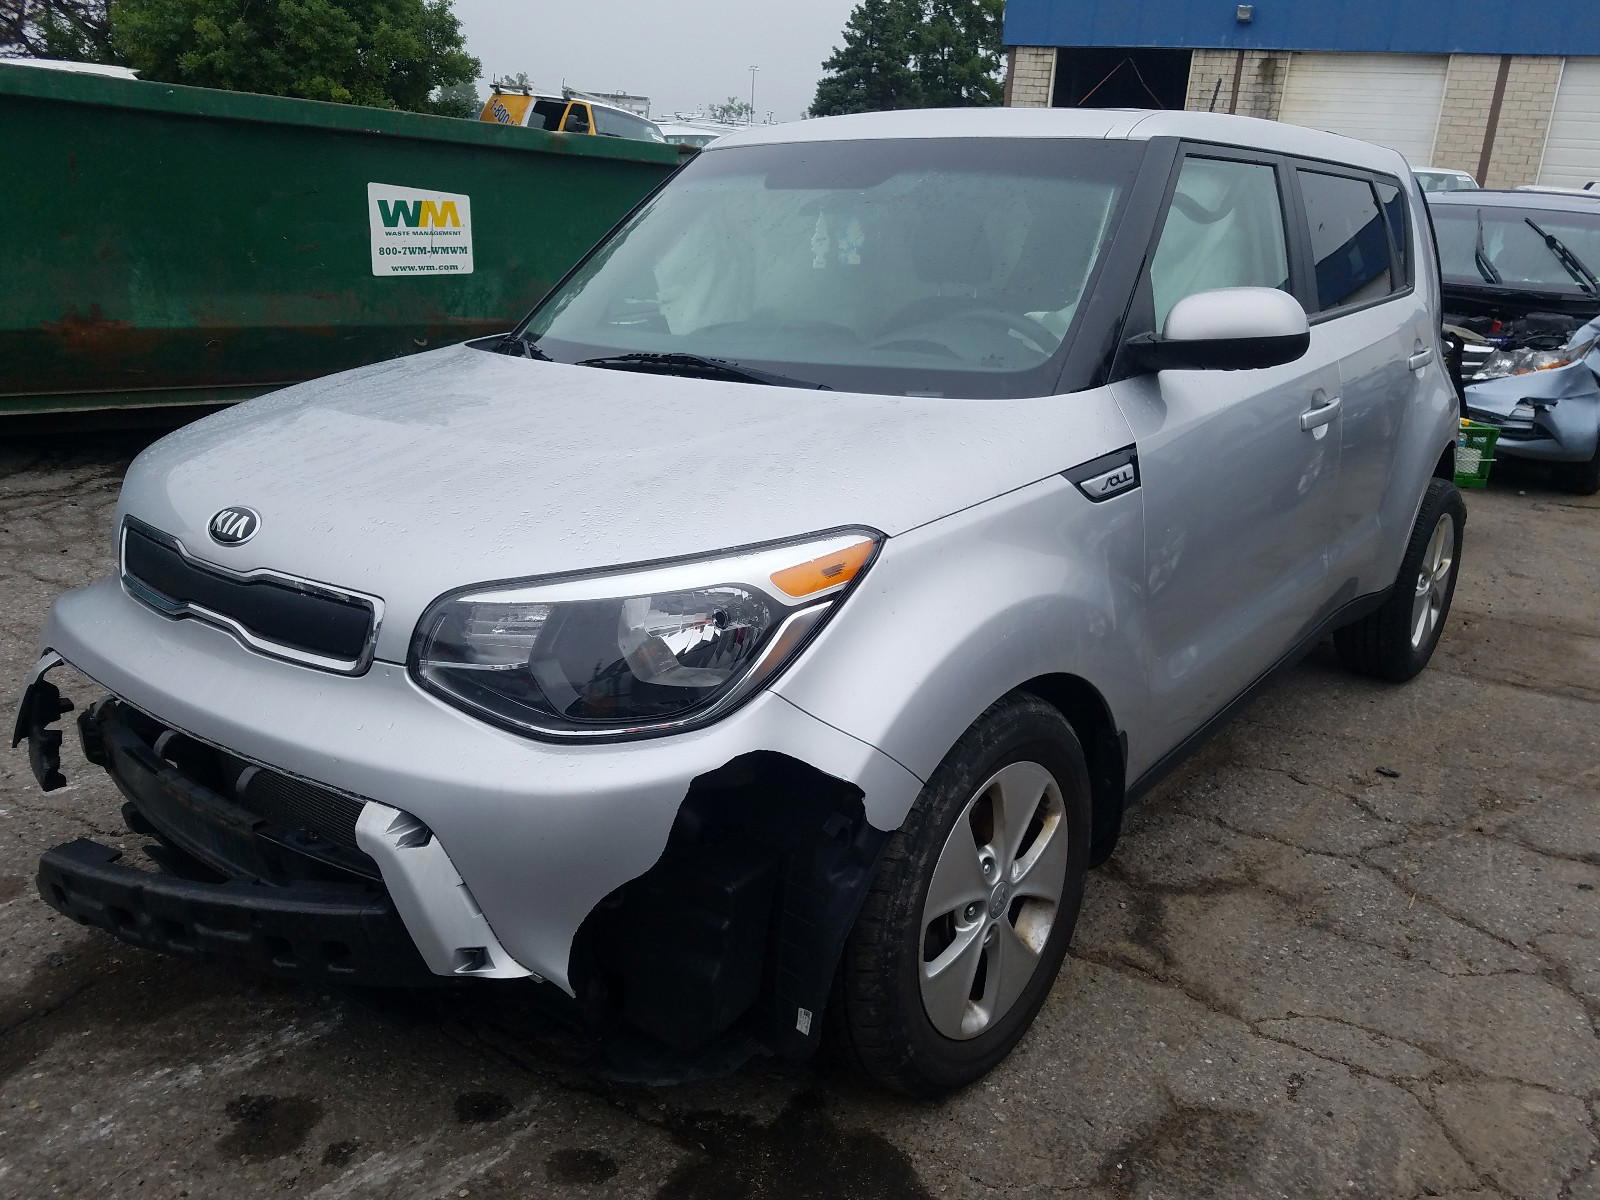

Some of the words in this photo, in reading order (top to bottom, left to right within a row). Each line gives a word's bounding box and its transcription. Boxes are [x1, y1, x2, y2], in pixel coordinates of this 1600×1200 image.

[377, 199, 461, 228] WM
[378, 246, 468, 256] 800-7WM-WMWM
[391, 264, 459, 272] www.wm.com
[211, 510, 250, 539] KIA
